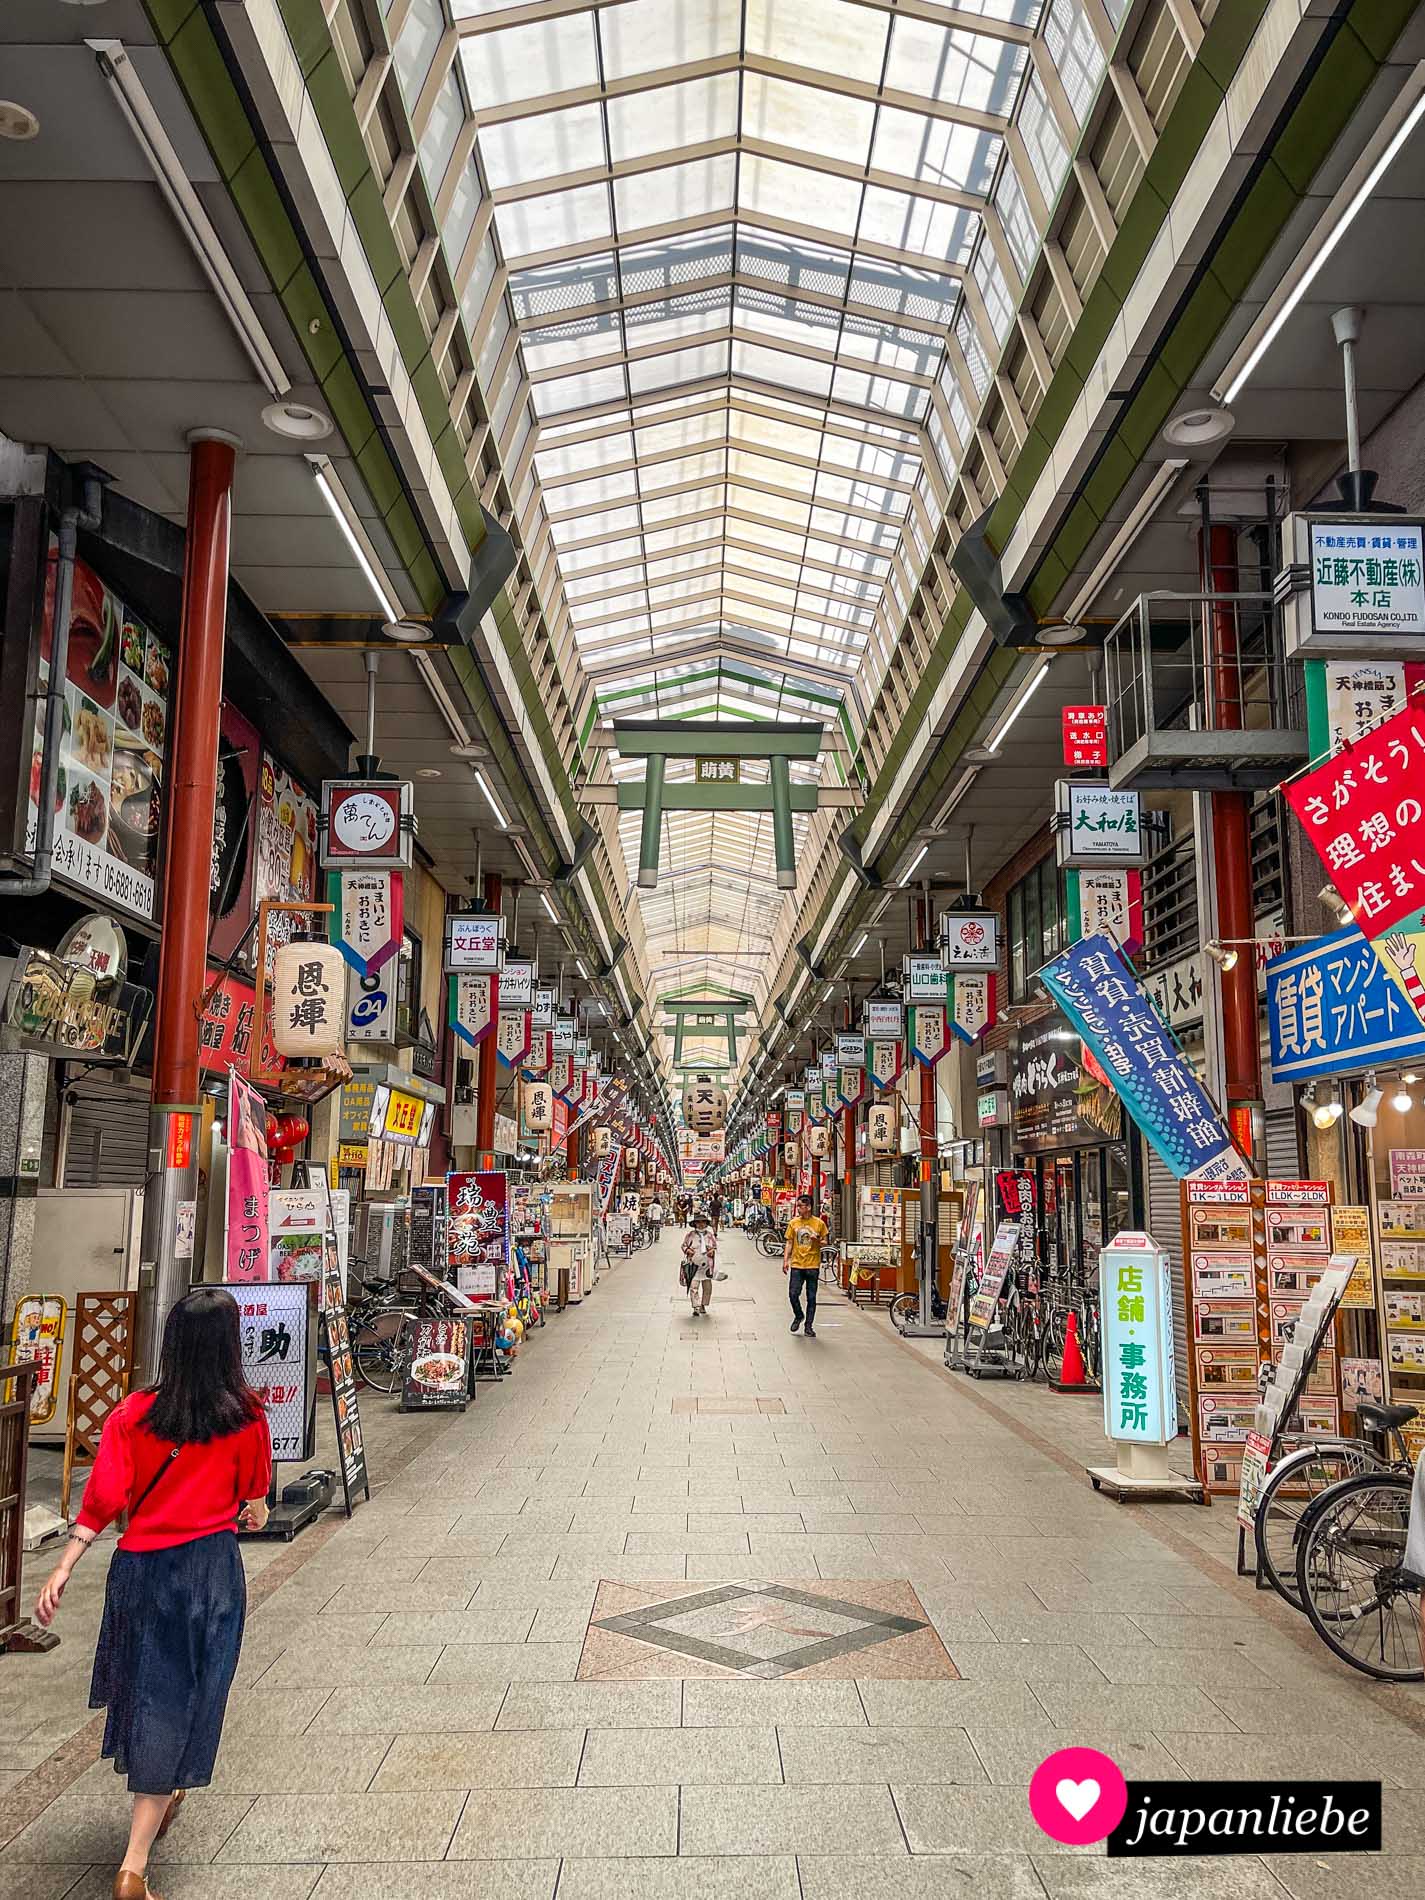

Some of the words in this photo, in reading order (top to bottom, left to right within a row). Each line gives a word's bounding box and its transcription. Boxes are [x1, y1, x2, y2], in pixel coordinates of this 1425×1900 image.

[1315, 536, 1417, 549] 不動産売買・賃貸・管理
[1316, 557, 1421, 587] 近藤不動産(株)
[1350, 590, 1391, 608] 本店
[1323, 612, 1351, 621] KONDO
[1353, 612, 1389, 621] FUDOSAN
[1073, 808, 1137, 833] 大和屋
[1325, 798, 1422, 871] 理想の
[358, 895, 370, 943] おおきに
[373, 892, 386, 927] まいど
[1111, 891, 1123, 925] まいど
[454, 936, 496, 951] 文丘堂
[457, 925, 493, 933] ぶんぼうぐ
[355, 998, 383, 1018] OA
[468, 992, 477, 1023] おおきに
[478, 990, 487, 1013] まいど
[965, 991, 974, 1024] おおきに
[1275, 963, 1327, 1060] 賃貸
[1331, 992, 1400, 1046] アパート
[696, 1089, 714, 1127] 天三
[238, 1195, 261, 1272] まつげ
[1117, 1264, 1148, 1432] 店舗・事務所
